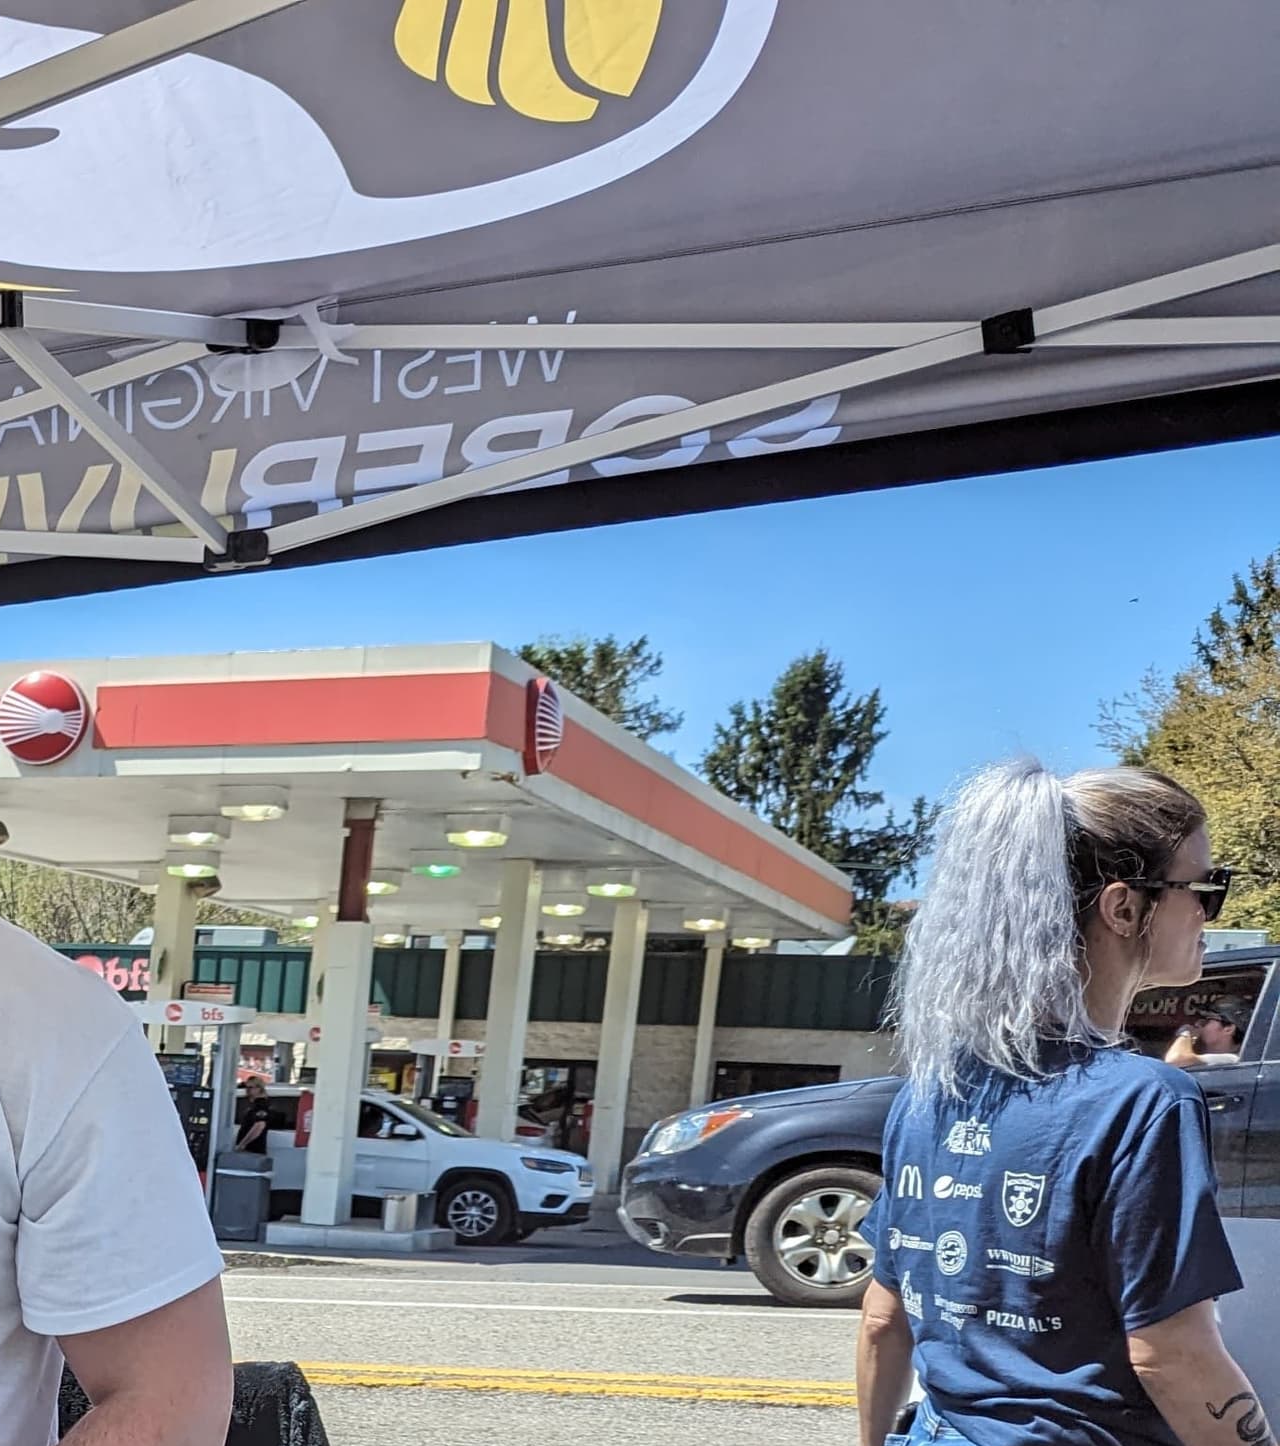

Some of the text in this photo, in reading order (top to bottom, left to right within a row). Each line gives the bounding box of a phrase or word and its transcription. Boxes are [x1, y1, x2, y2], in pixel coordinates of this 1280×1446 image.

[201, 1008, 224, 1021] bfs
[953, 1182, 984, 1200] pepsi
[986, 1310, 1026, 1331] PIZZA
[1028, 1315, 1063, 1333] AL'S
